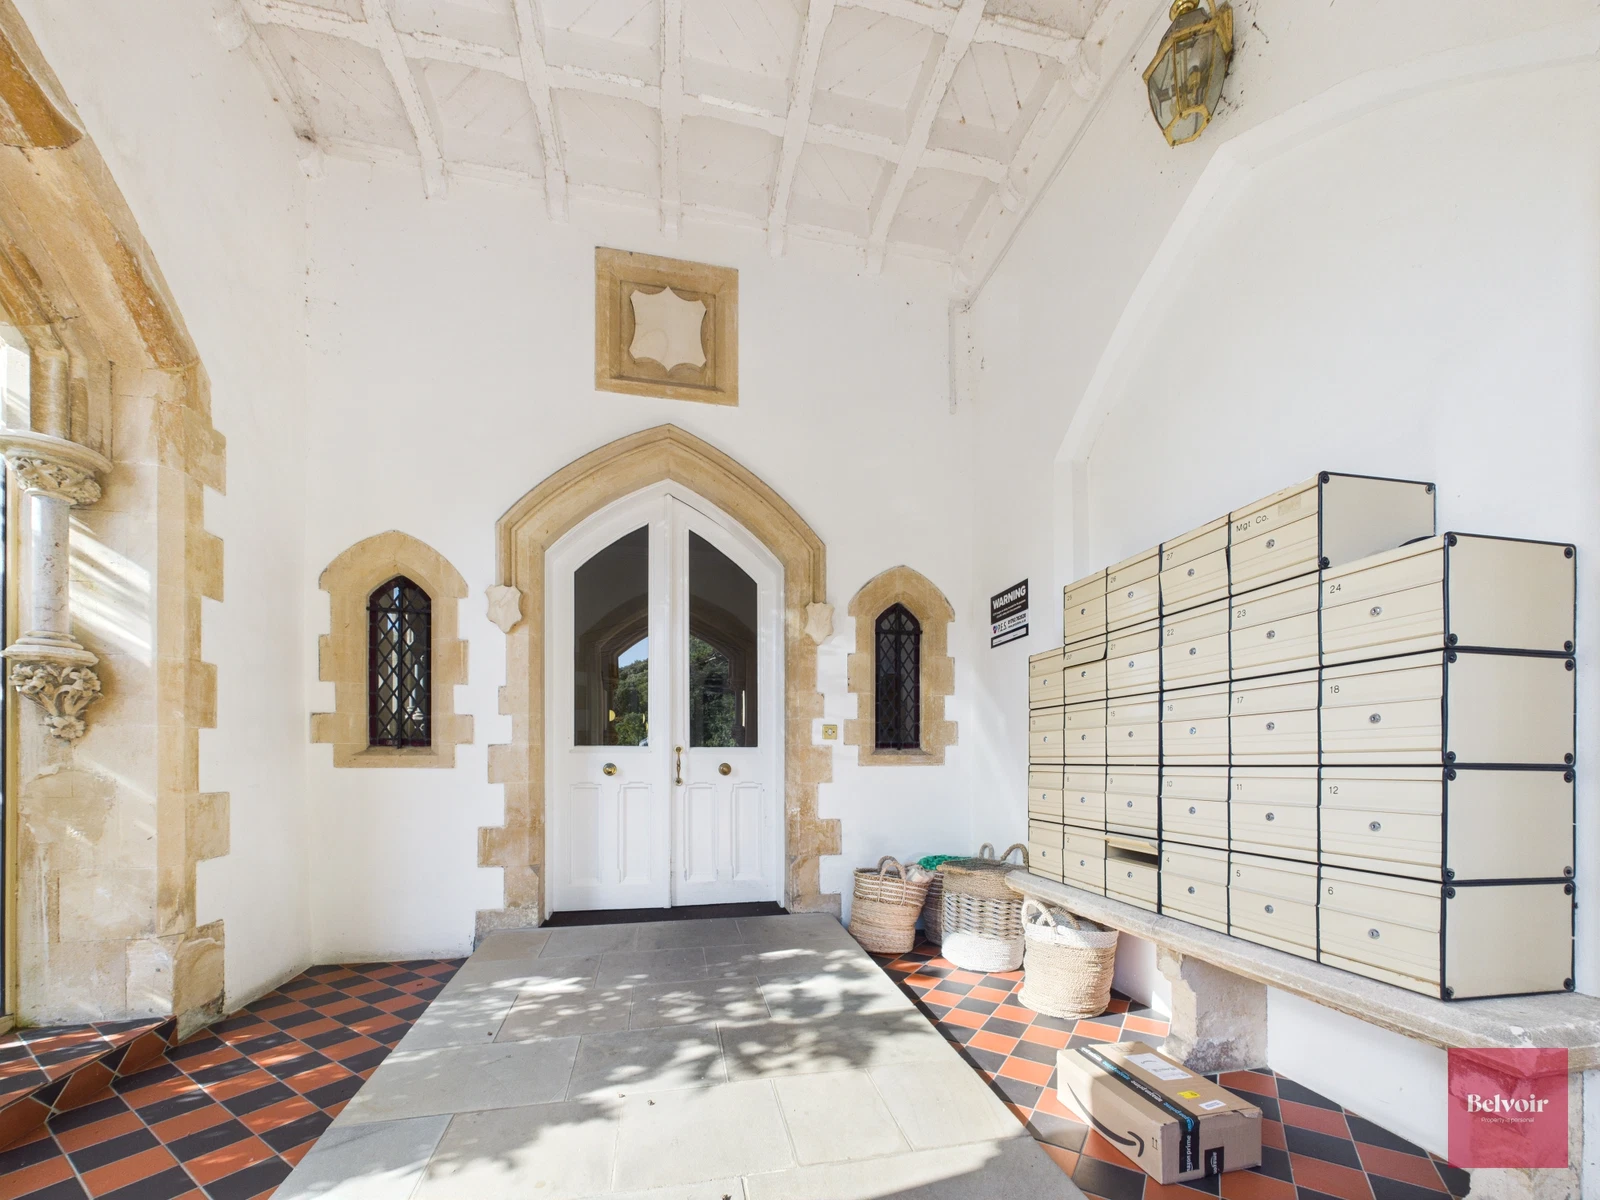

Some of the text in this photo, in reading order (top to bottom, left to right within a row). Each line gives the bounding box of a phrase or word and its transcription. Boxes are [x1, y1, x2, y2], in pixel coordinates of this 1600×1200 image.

[1236, 514, 1269, 532] Mgt Co.
[1166, 552, 1173, 560] 27
[1329, 584, 1341, 594] 24
[992, 585, 1026, 610] WARNING
[1236, 609, 1246, 618] 23
[1166, 628, 1174, 637] 22
[1330, 684, 1340, 694] 18
[1237, 697, 1243, 705] 17
[1166, 780, 1173, 788] 10
[1329, 786, 1339, 795] 12
[1236, 870, 1241, 878] 5
[1328, 886, 1333, 895] 6
